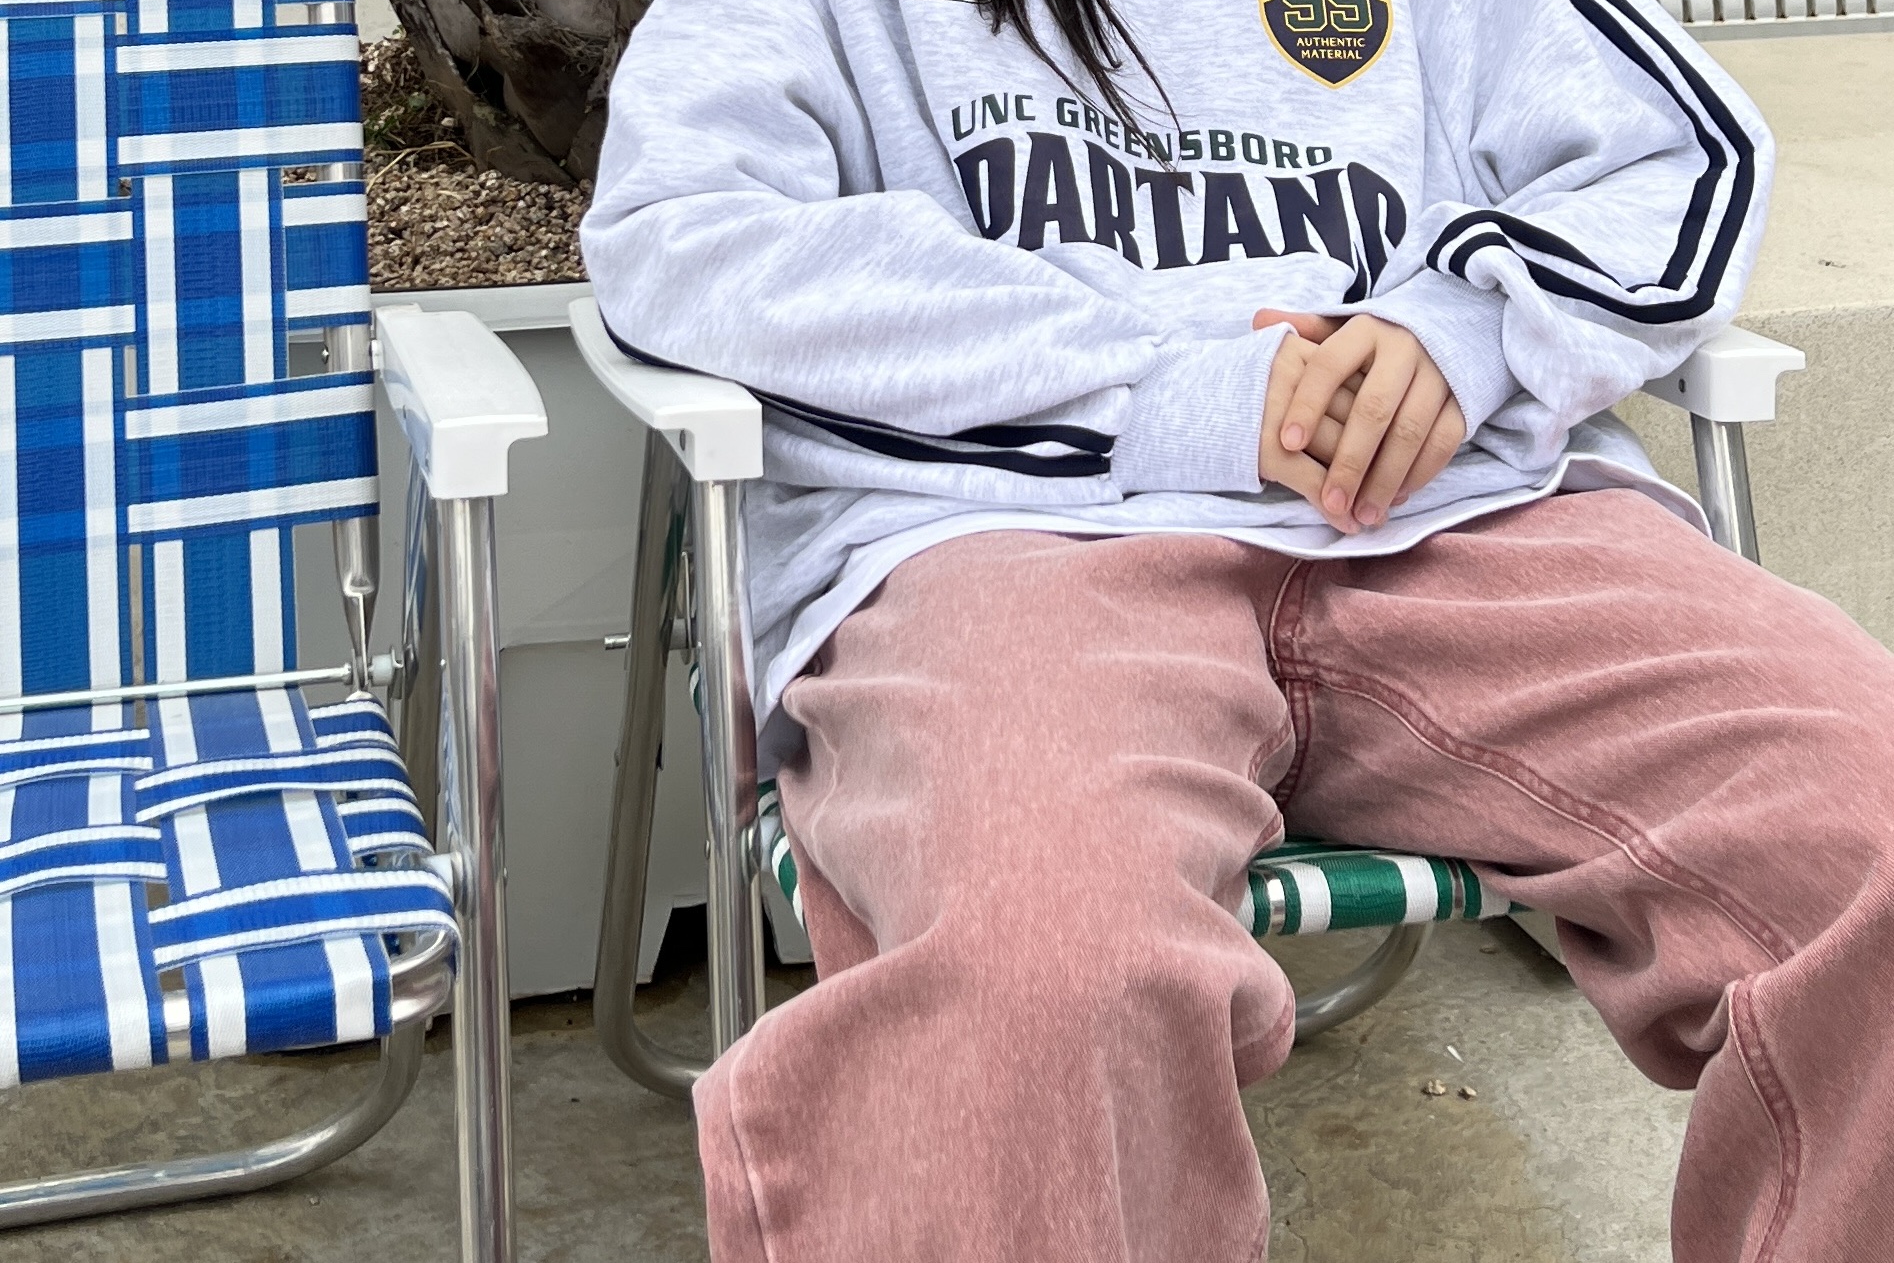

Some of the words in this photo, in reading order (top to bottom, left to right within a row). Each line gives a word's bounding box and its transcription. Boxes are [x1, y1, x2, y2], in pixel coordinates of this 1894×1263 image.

[1296, 37, 1366, 47] AUTHENTIC
[1301, 49, 1363, 60] MATERIAL
[951, 93, 1036, 142] UNC
[1056, 97, 1333, 169] GREENSBORO
